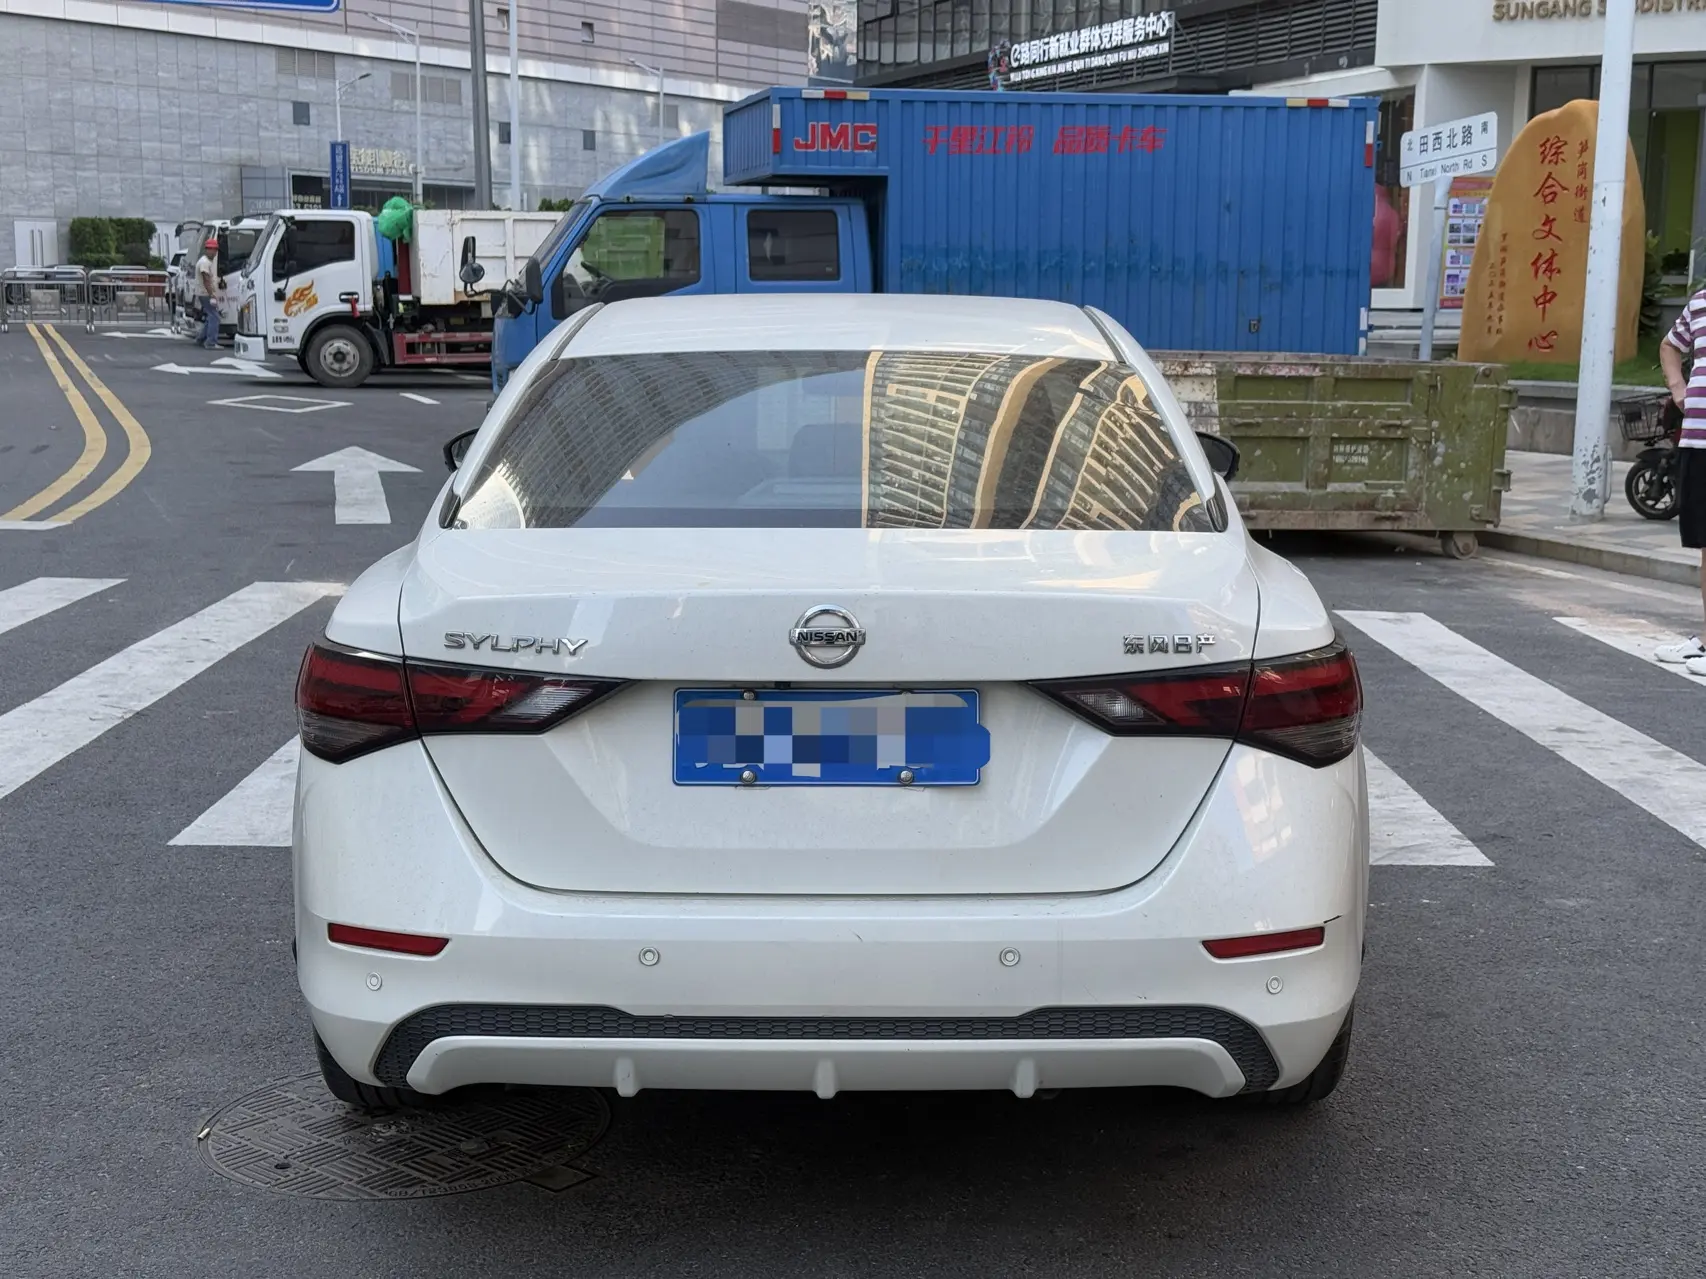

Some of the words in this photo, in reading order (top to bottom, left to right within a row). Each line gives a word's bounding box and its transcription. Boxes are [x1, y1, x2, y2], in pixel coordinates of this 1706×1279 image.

[1492, 0, 1592, 21] SUNGANG
[1073, 59, 1084, 72] QUN
[1091, 55, 1106, 68] DANG
[1106, 53, 1119, 67] QUN
[1119, 51, 1128, 62] FU
[1138, 44, 1158, 58] ZHONG
[1158, 42, 1169, 53] XIN
[793, 121, 878, 152] JMC
[1052, 125, 1169, 155] 品质卡车
[1419, 124, 1473, 156] 田西北路
[1480, 121, 1488, 135] 南
[1406, 171, 1412, 182] N
[1441, 161, 1459, 174] North
[1463, 158, 1473, 170] Rd
[1481, 154, 1488, 167] S
[1573, 139, 1590, 224] 笋岗街道
[1527, 135, 1569, 350] 综合文体中心
[444, 631, 588, 656] SYLPHY
[797, 631, 858, 642] NISSAN
[1123, 633, 1217, 654] 东风日产
